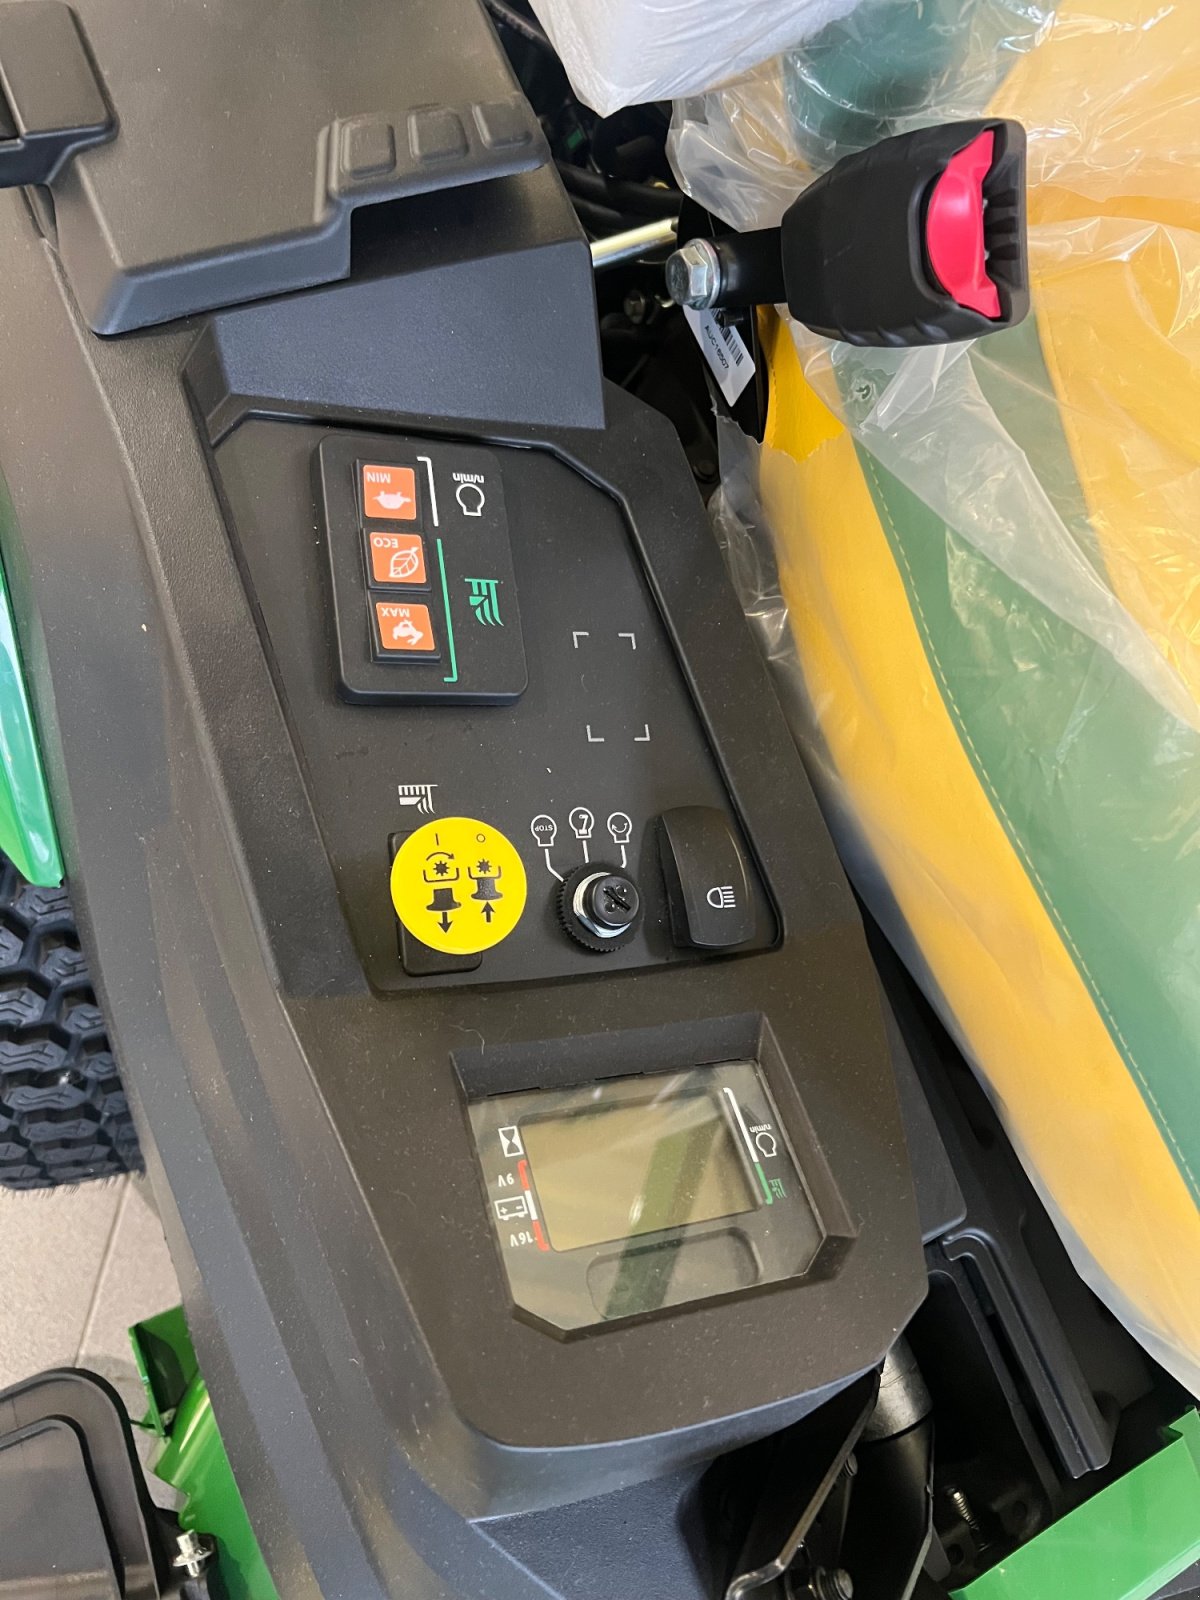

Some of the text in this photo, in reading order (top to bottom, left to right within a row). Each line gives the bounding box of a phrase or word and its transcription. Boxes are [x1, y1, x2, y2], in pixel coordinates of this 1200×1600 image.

[366, 471, 392, 484] MIN
[452, 472, 485, 484] n/min
[373, 537, 399, 549] ECO
[381, 606, 410, 618] MAX
[534, 823, 554, 832] STOP
[749, 1123, 772, 1134] n/min
